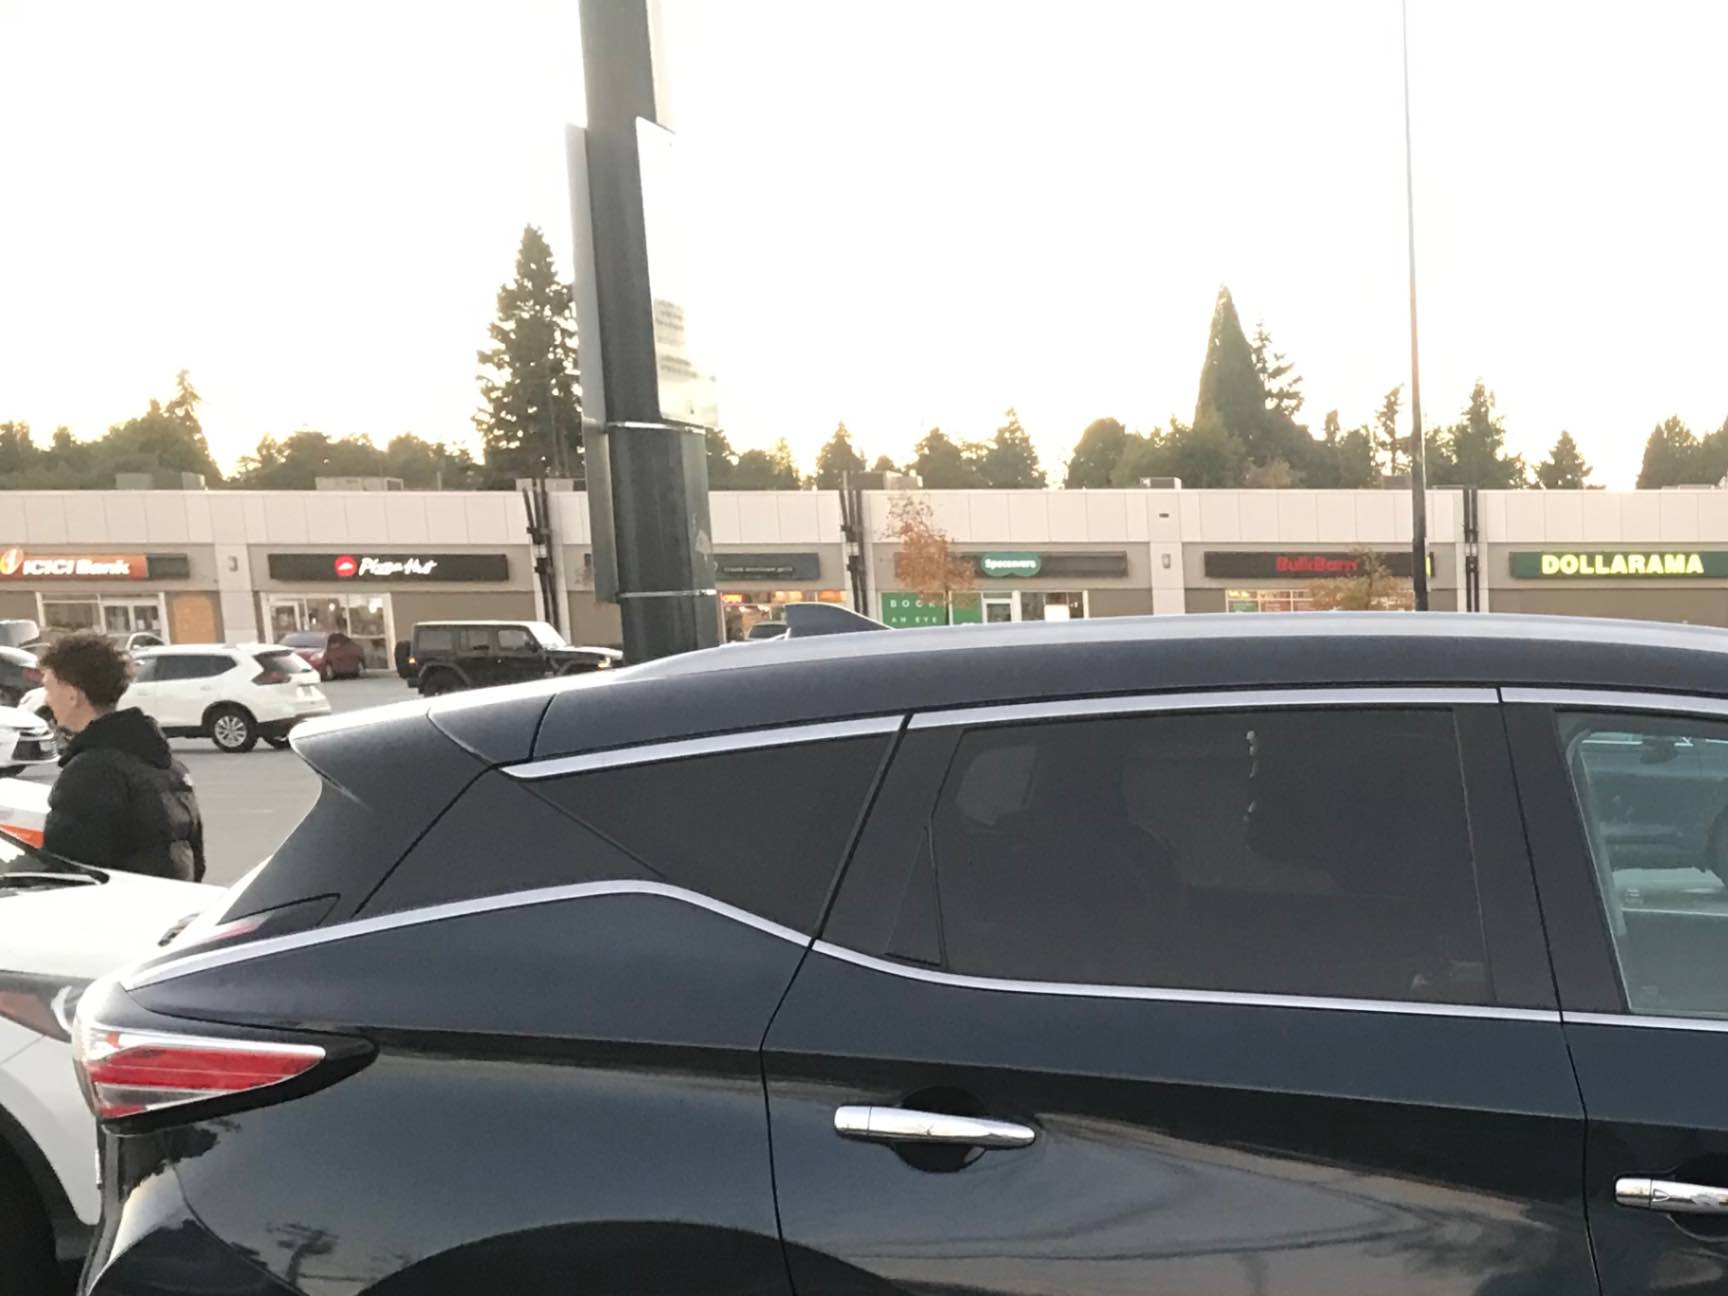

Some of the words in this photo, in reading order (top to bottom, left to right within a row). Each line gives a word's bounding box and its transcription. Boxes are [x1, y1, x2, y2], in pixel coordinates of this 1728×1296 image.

[23, 559, 74, 575] ICICI
[76, 559, 130, 575] Bank
[358, 557, 402, 576] Pizza
[403, 557, 437, 575] Hut
[984, 558, 1036, 570] Specsavers
[1541, 554, 1704, 575] DOLLARAMA
